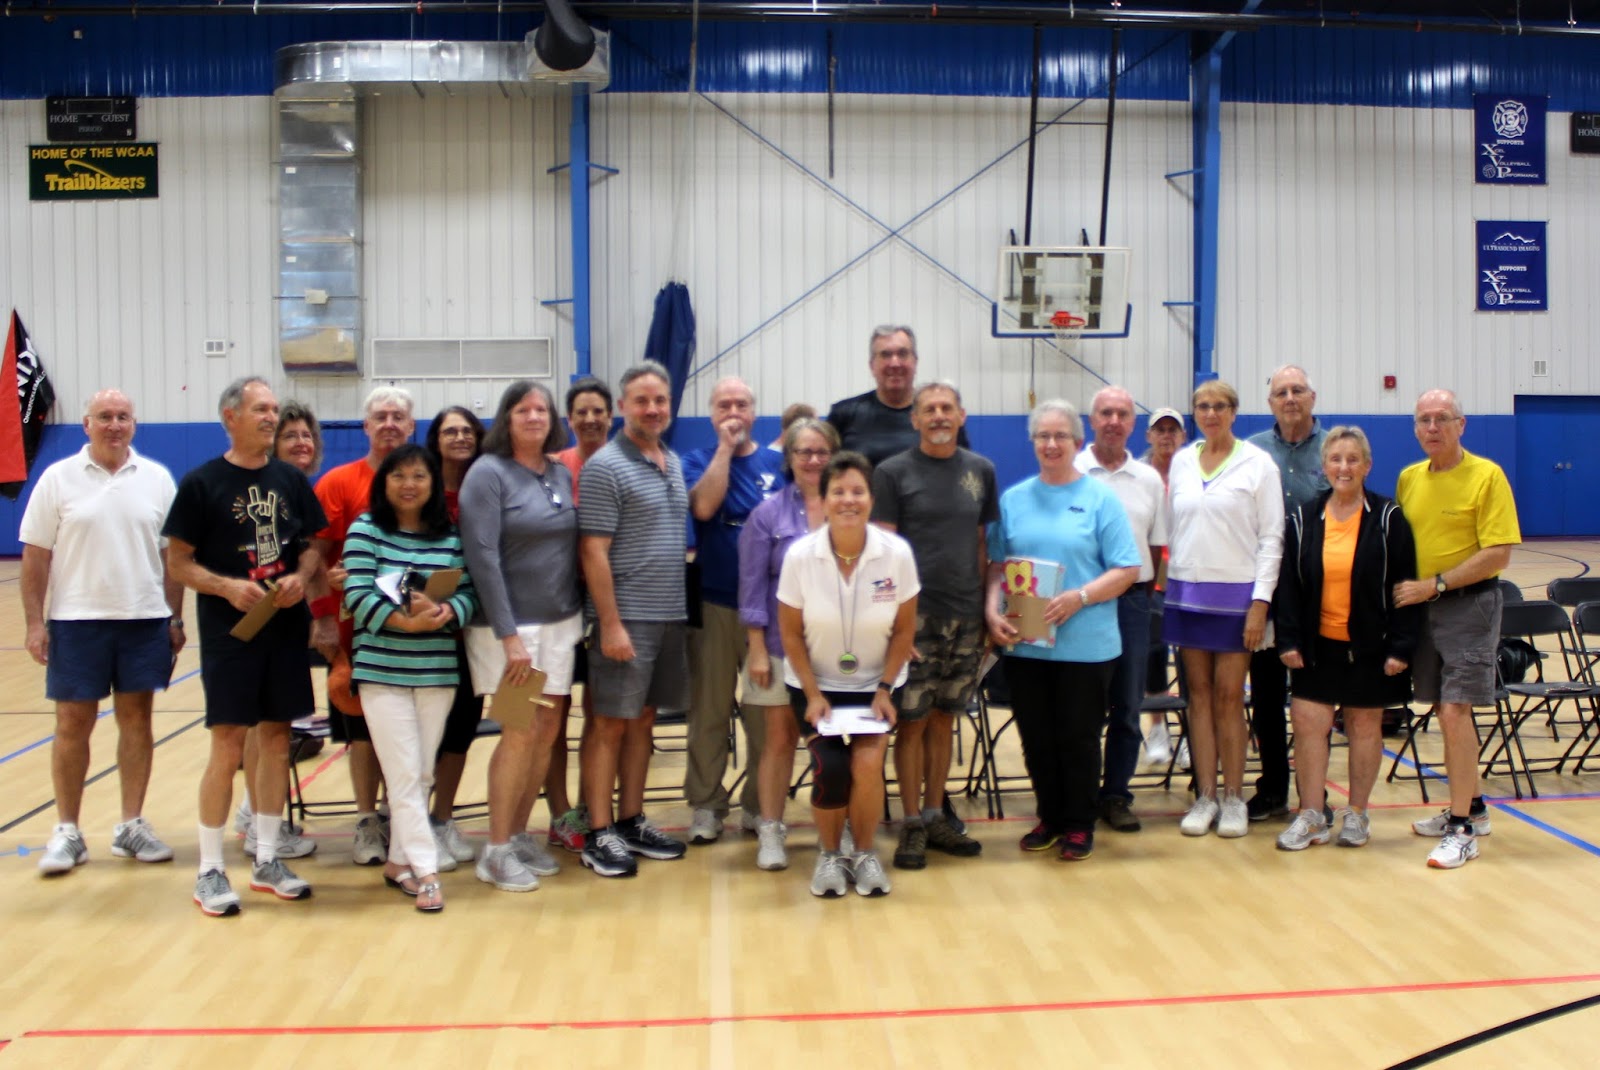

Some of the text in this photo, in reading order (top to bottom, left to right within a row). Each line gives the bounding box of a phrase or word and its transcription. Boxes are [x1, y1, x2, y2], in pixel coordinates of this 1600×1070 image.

[50, 114, 78, 123] HOME
[101, 113, 130, 122] GUEST
[32, 146, 155, 159] HOME OF THE WCAA
[45, 172, 146, 191] Trailblazers
[1498, 293, 1541, 305] PERFORMANCE
